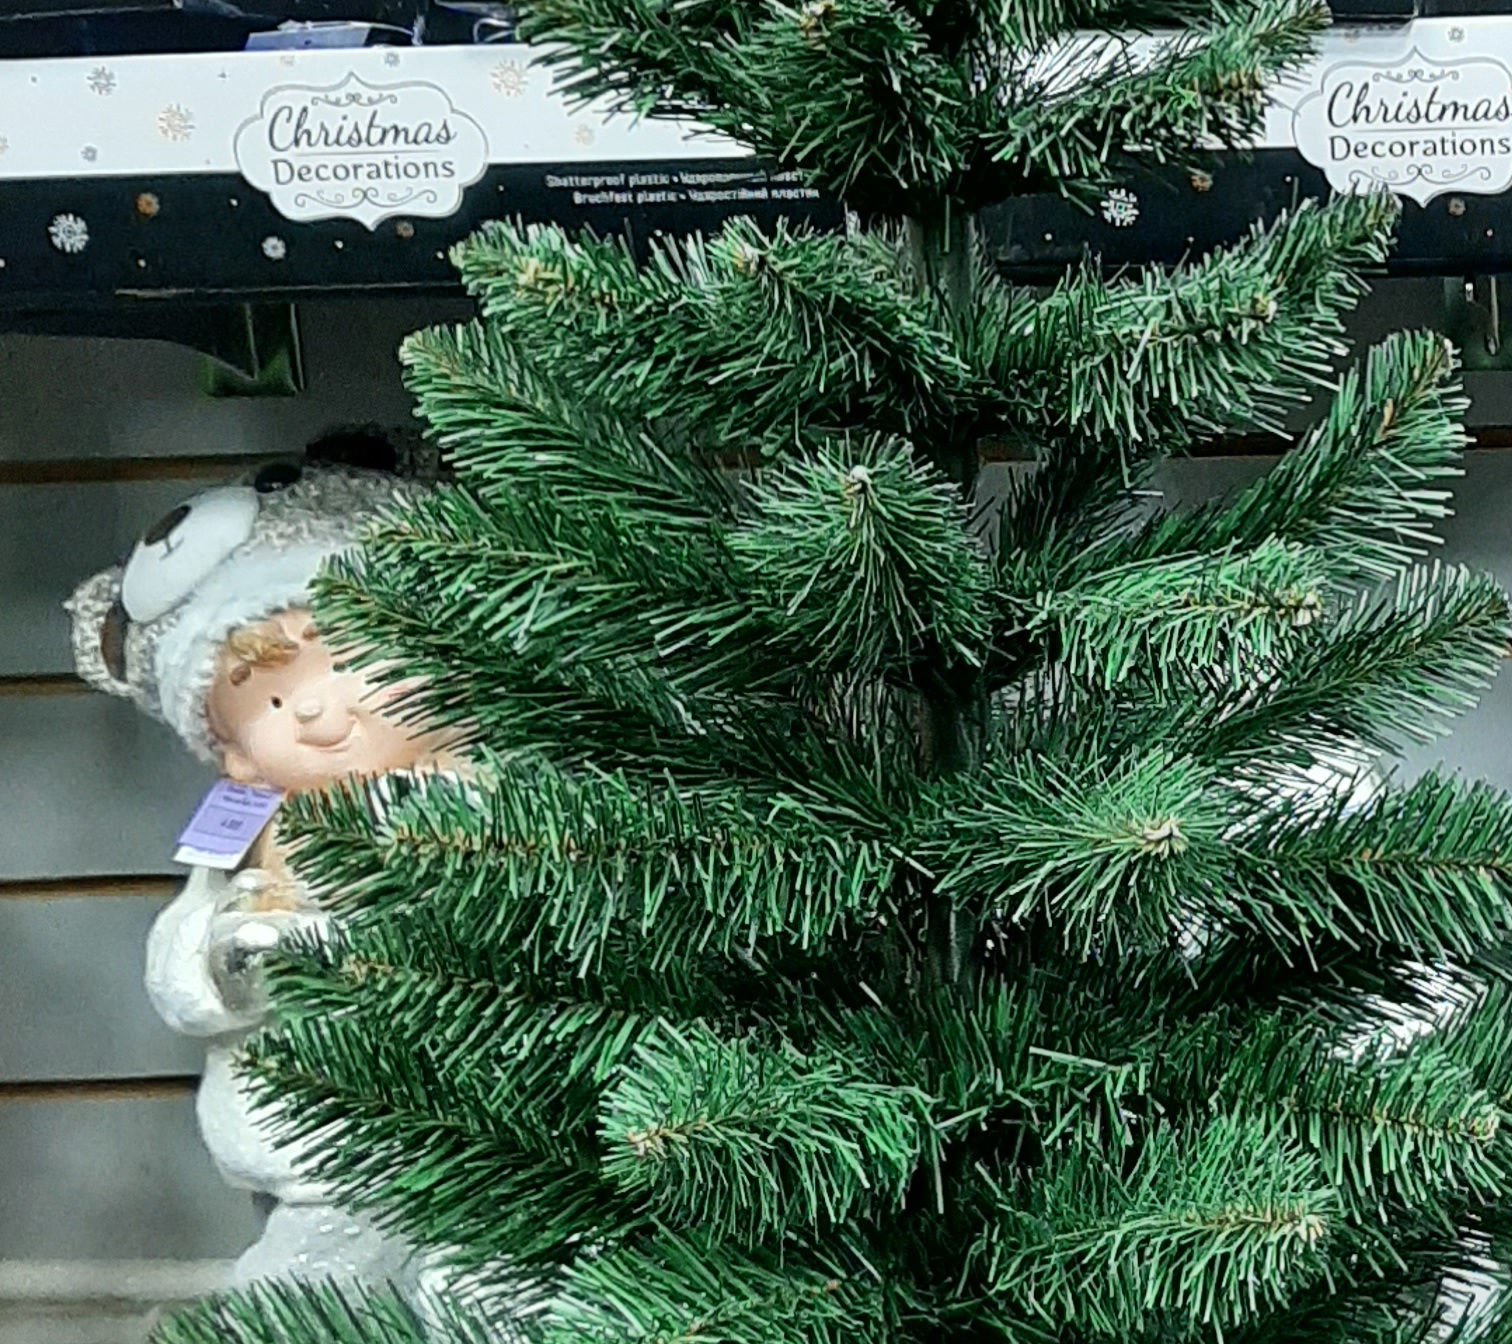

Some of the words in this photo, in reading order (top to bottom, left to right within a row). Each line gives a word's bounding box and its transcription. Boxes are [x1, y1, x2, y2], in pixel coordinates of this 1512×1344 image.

[268, 105, 457, 152] Christmas
[1329, 131, 1512, 161] Decorations
[271, 155, 455, 185] Decorations
